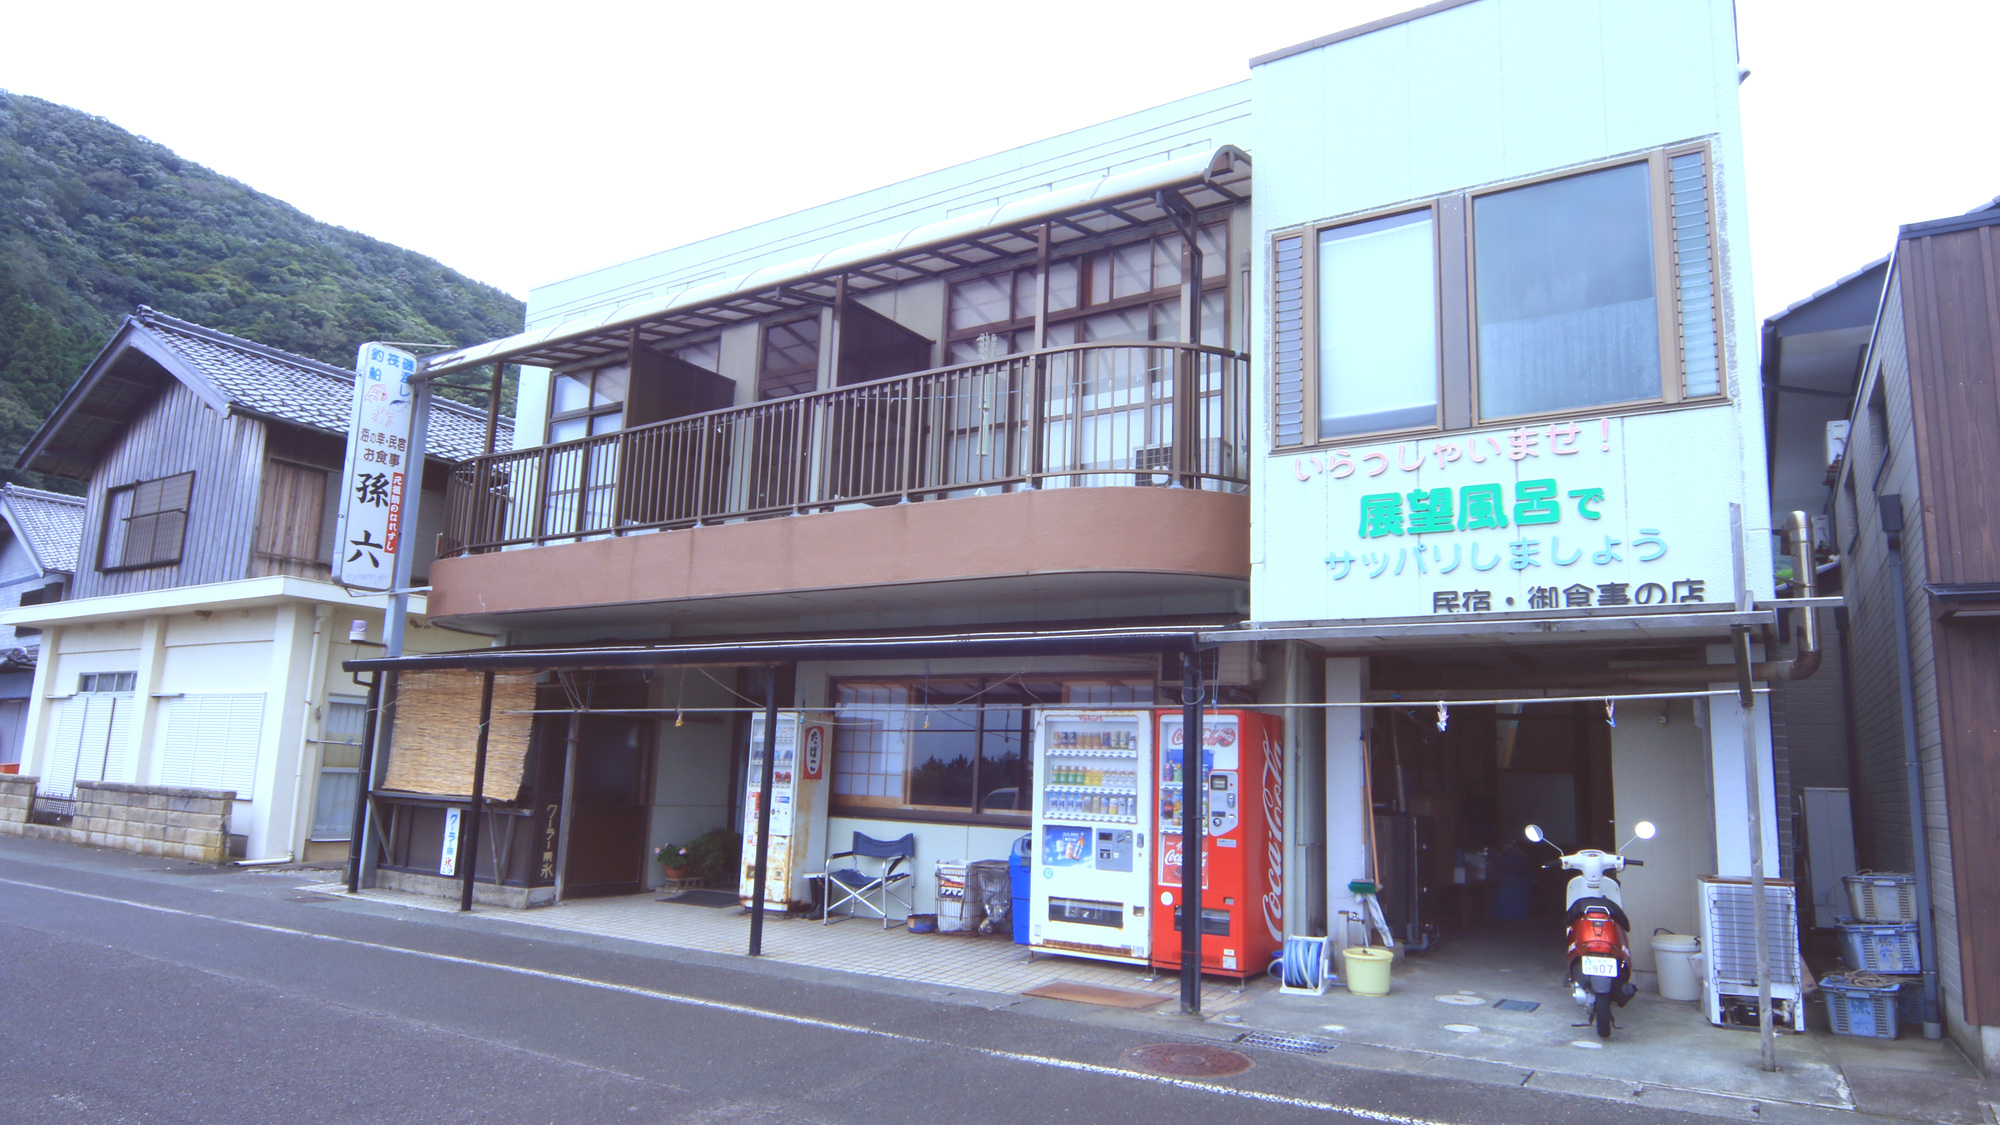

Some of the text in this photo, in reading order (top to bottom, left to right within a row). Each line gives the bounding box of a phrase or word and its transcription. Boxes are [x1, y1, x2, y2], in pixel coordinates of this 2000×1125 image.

[363, 448, 401, 467] お食事
[347, 472, 389, 569] 孫六
[1358, 478, 1605, 538] 展望風呂で
[1324, 528, 1668, 580] サッパリしましょう
[1432, 577, 1705, 614] 民宿・御食事の店
[809, 730, 820, 772] たばこ
[541, 804, 558, 879] クーラー用氷
[1592, 964, 1613, 974] 907
